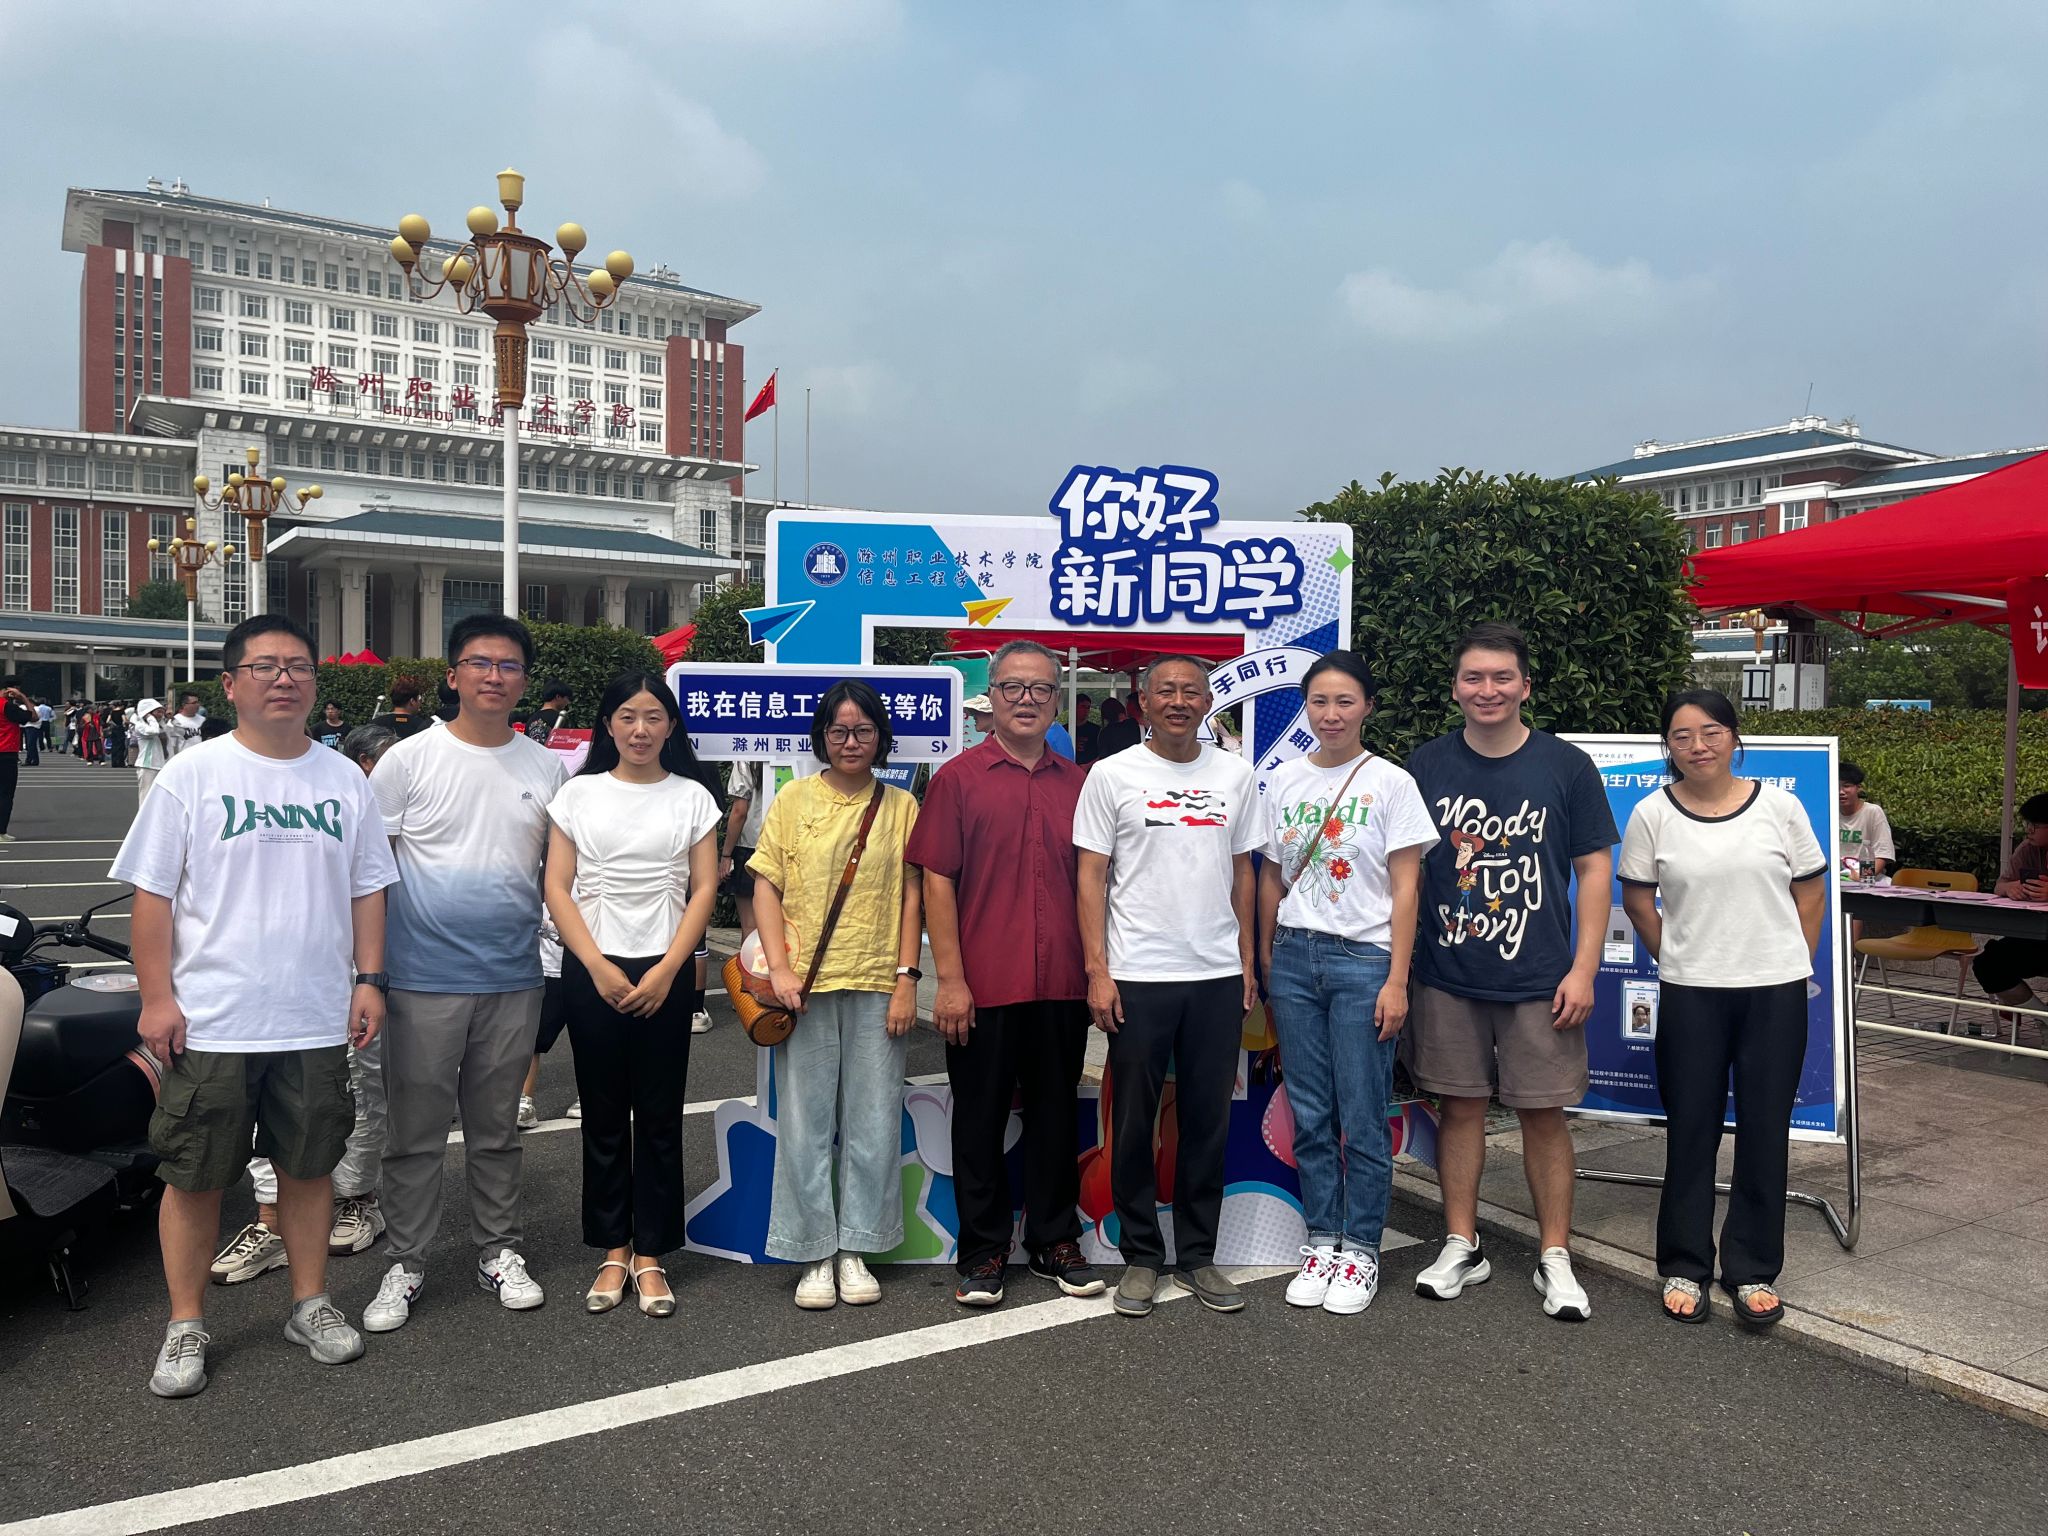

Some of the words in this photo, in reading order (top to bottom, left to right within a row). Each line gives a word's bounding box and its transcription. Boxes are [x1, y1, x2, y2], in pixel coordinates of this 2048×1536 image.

[383, 403, 453, 423] CHUZHOU
[478, 415, 579, 437] POLTECHNIC
[1058, 473, 1211, 541] 你好
[857, 547, 1043, 569] 滁州职业技术学院
[857, 570, 995, 588] 信息工程学院
[1058, 546, 1296, 620] 新同学
[931, 741, 940, 753] S
[1436, 795, 1547, 843] Woody
[1472, 852, 1542, 910] Toy
[1438, 904, 1528, 960] Story
